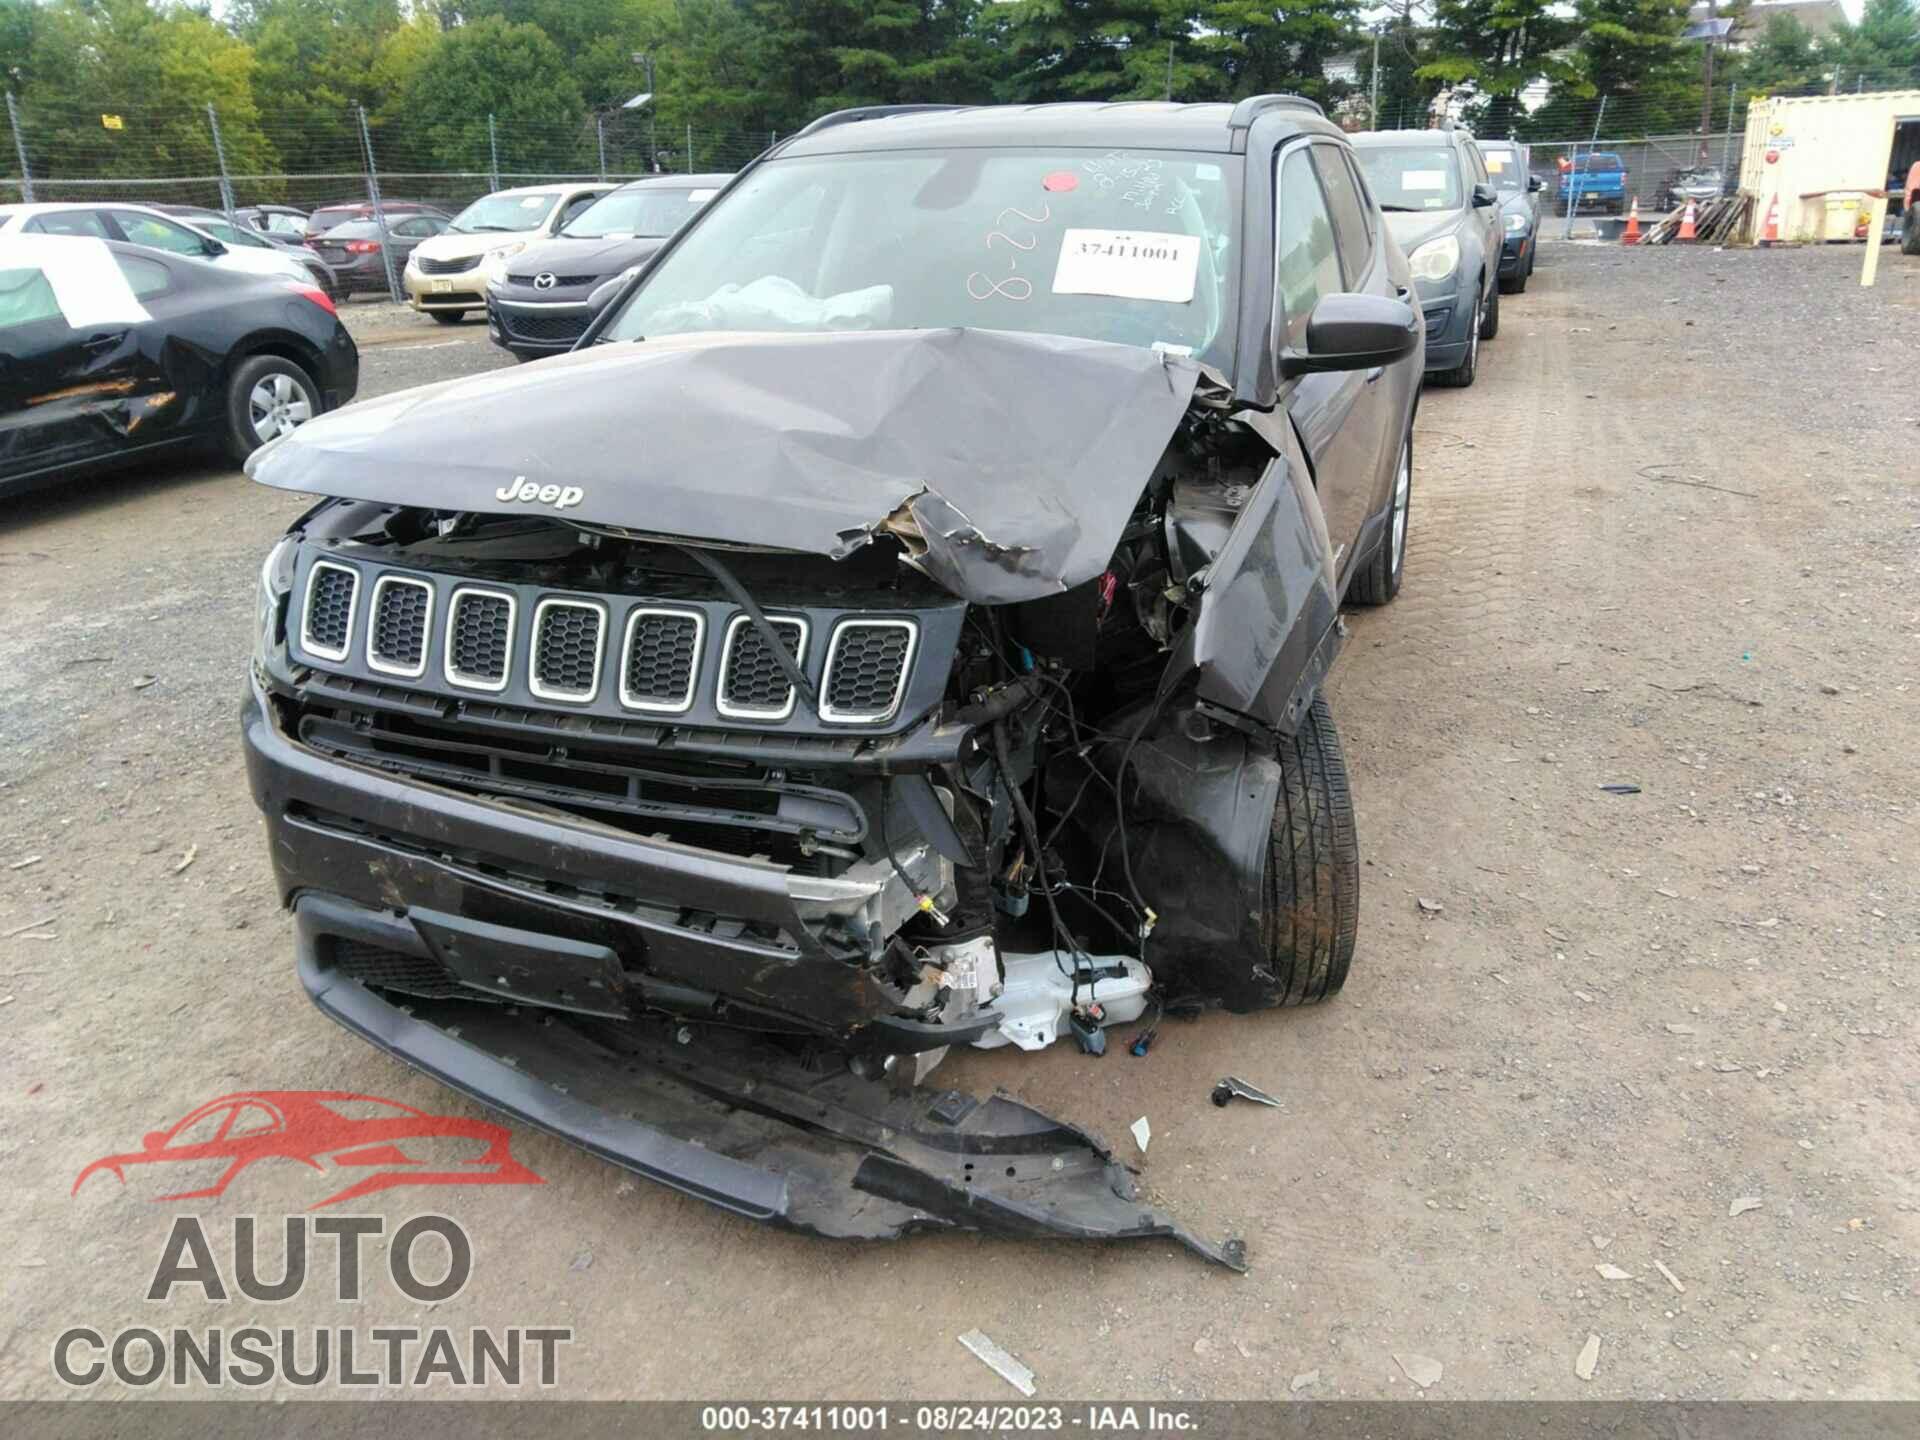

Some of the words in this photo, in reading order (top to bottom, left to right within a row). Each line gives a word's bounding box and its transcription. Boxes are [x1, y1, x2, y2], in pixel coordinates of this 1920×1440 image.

[966, 199, 1050, 300] 8-22
[1077, 242, 1178, 261] 37411001
[495, 475, 585, 510] Jeep
